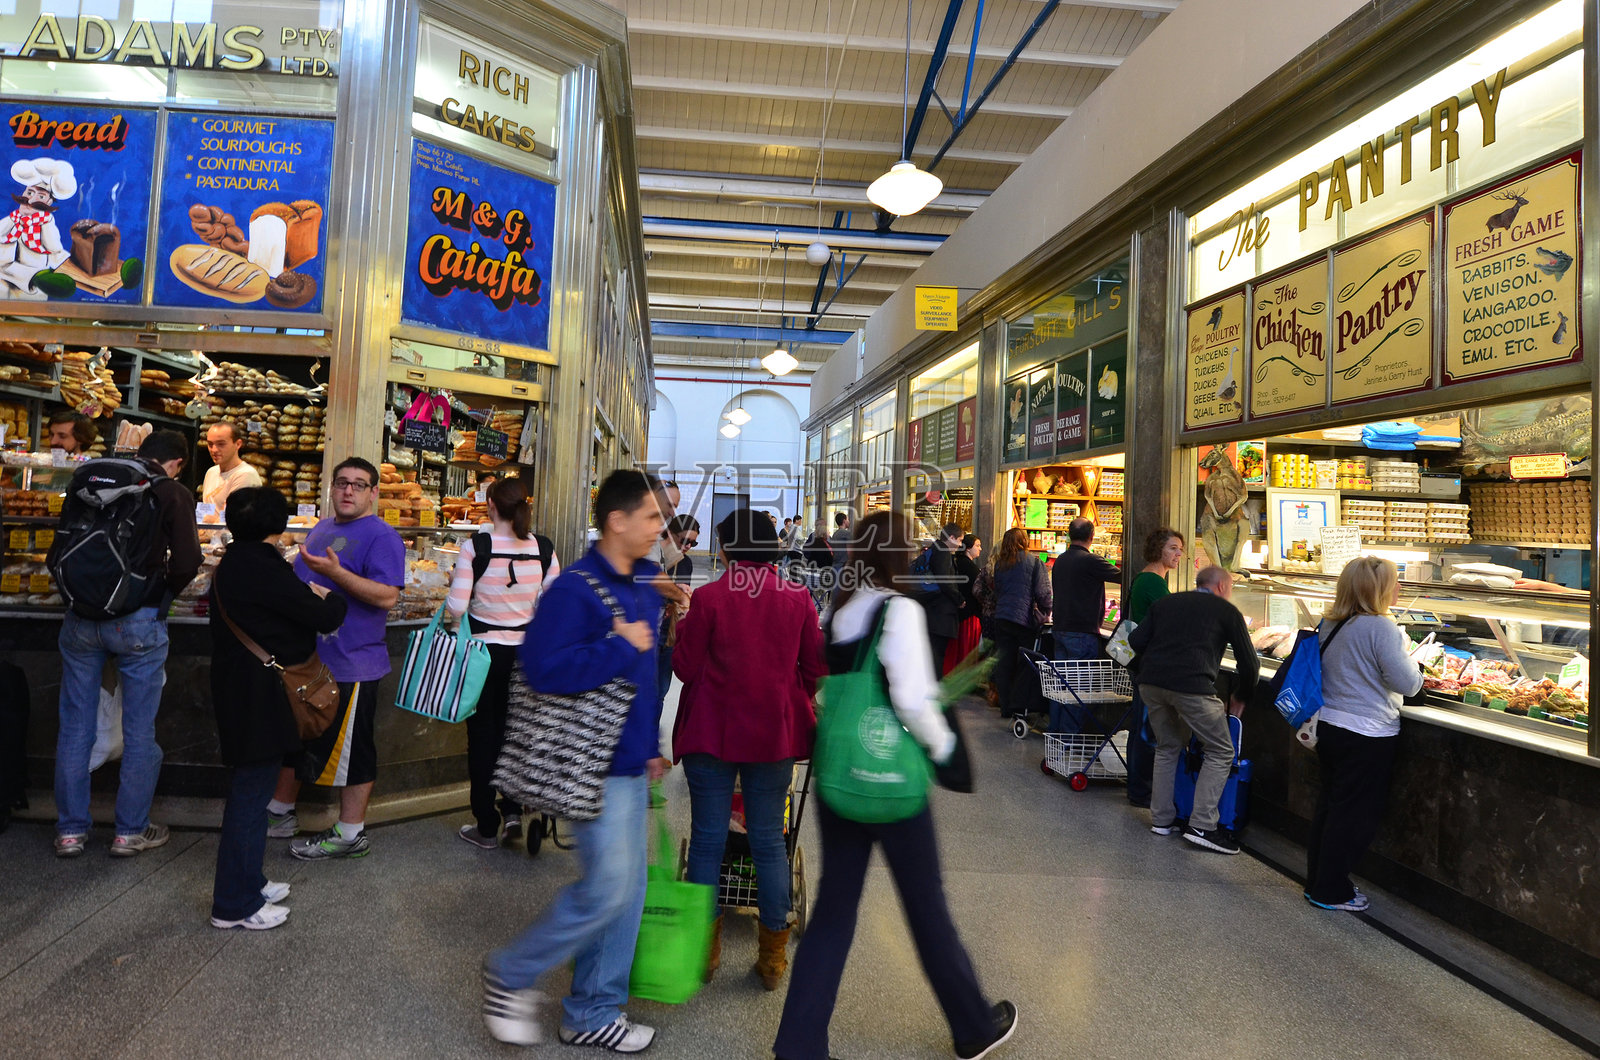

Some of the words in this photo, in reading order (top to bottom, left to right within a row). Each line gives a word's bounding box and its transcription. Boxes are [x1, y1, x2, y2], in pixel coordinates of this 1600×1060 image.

[17, 12, 266, 71] ADAMS
[280, 27, 335, 48] PTY.
[280, 56, 334, 77] LTD.
[459, 50, 529, 104] RICH
[9, 110, 128, 150] Bread
[202, 119, 277, 135] GOURMET
[441, 98, 536, 152] CAKES
[200, 138, 302, 155] SOURDOUGHS
[198, 157, 296, 173] CONTINENTAL
[1218, 202, 1271, 271] The
[1299, 67, 1507, 232] PANTRY
[196, 176, 279, 191] PASTADURA
[432, 186, 470, 228] M
[472, 201, 500, 233] &
[503, 209, 534, 248] G.
[1455, 232, 1503, 261] FRESH
[1511, 210, 1565, 242] GAME
[419, 234, 538, 303] Caiafa
[1462, 253, 1530, 284] RABBITS.
[1274, 284, 1297, 304] The
[1463, 271, 1542, 303] VENISON.
[1336, 269, 1427, 353] Pantry
[1463, 289, 1557, 324] KANGAROO.
[1206, 323, 1240, 345] POULTRY
[1255, 307, 1326, 361] Chicken
[1463, 311, 1555, 344] CROCODILE.
[1462, 346, 1498, 365] EMU.
[1505, 337, 1538, 356] ETC.
[1219, 402, 1234, 414] ETC.
[1035, 421, 1050, 434] FRESH
[1056, 418, 1065, 429] REE
[1065, 414, 1080, 427] RANGE
[1057, 431, 1062, 441] &
[1063, 427, 1081, 440] GAME
